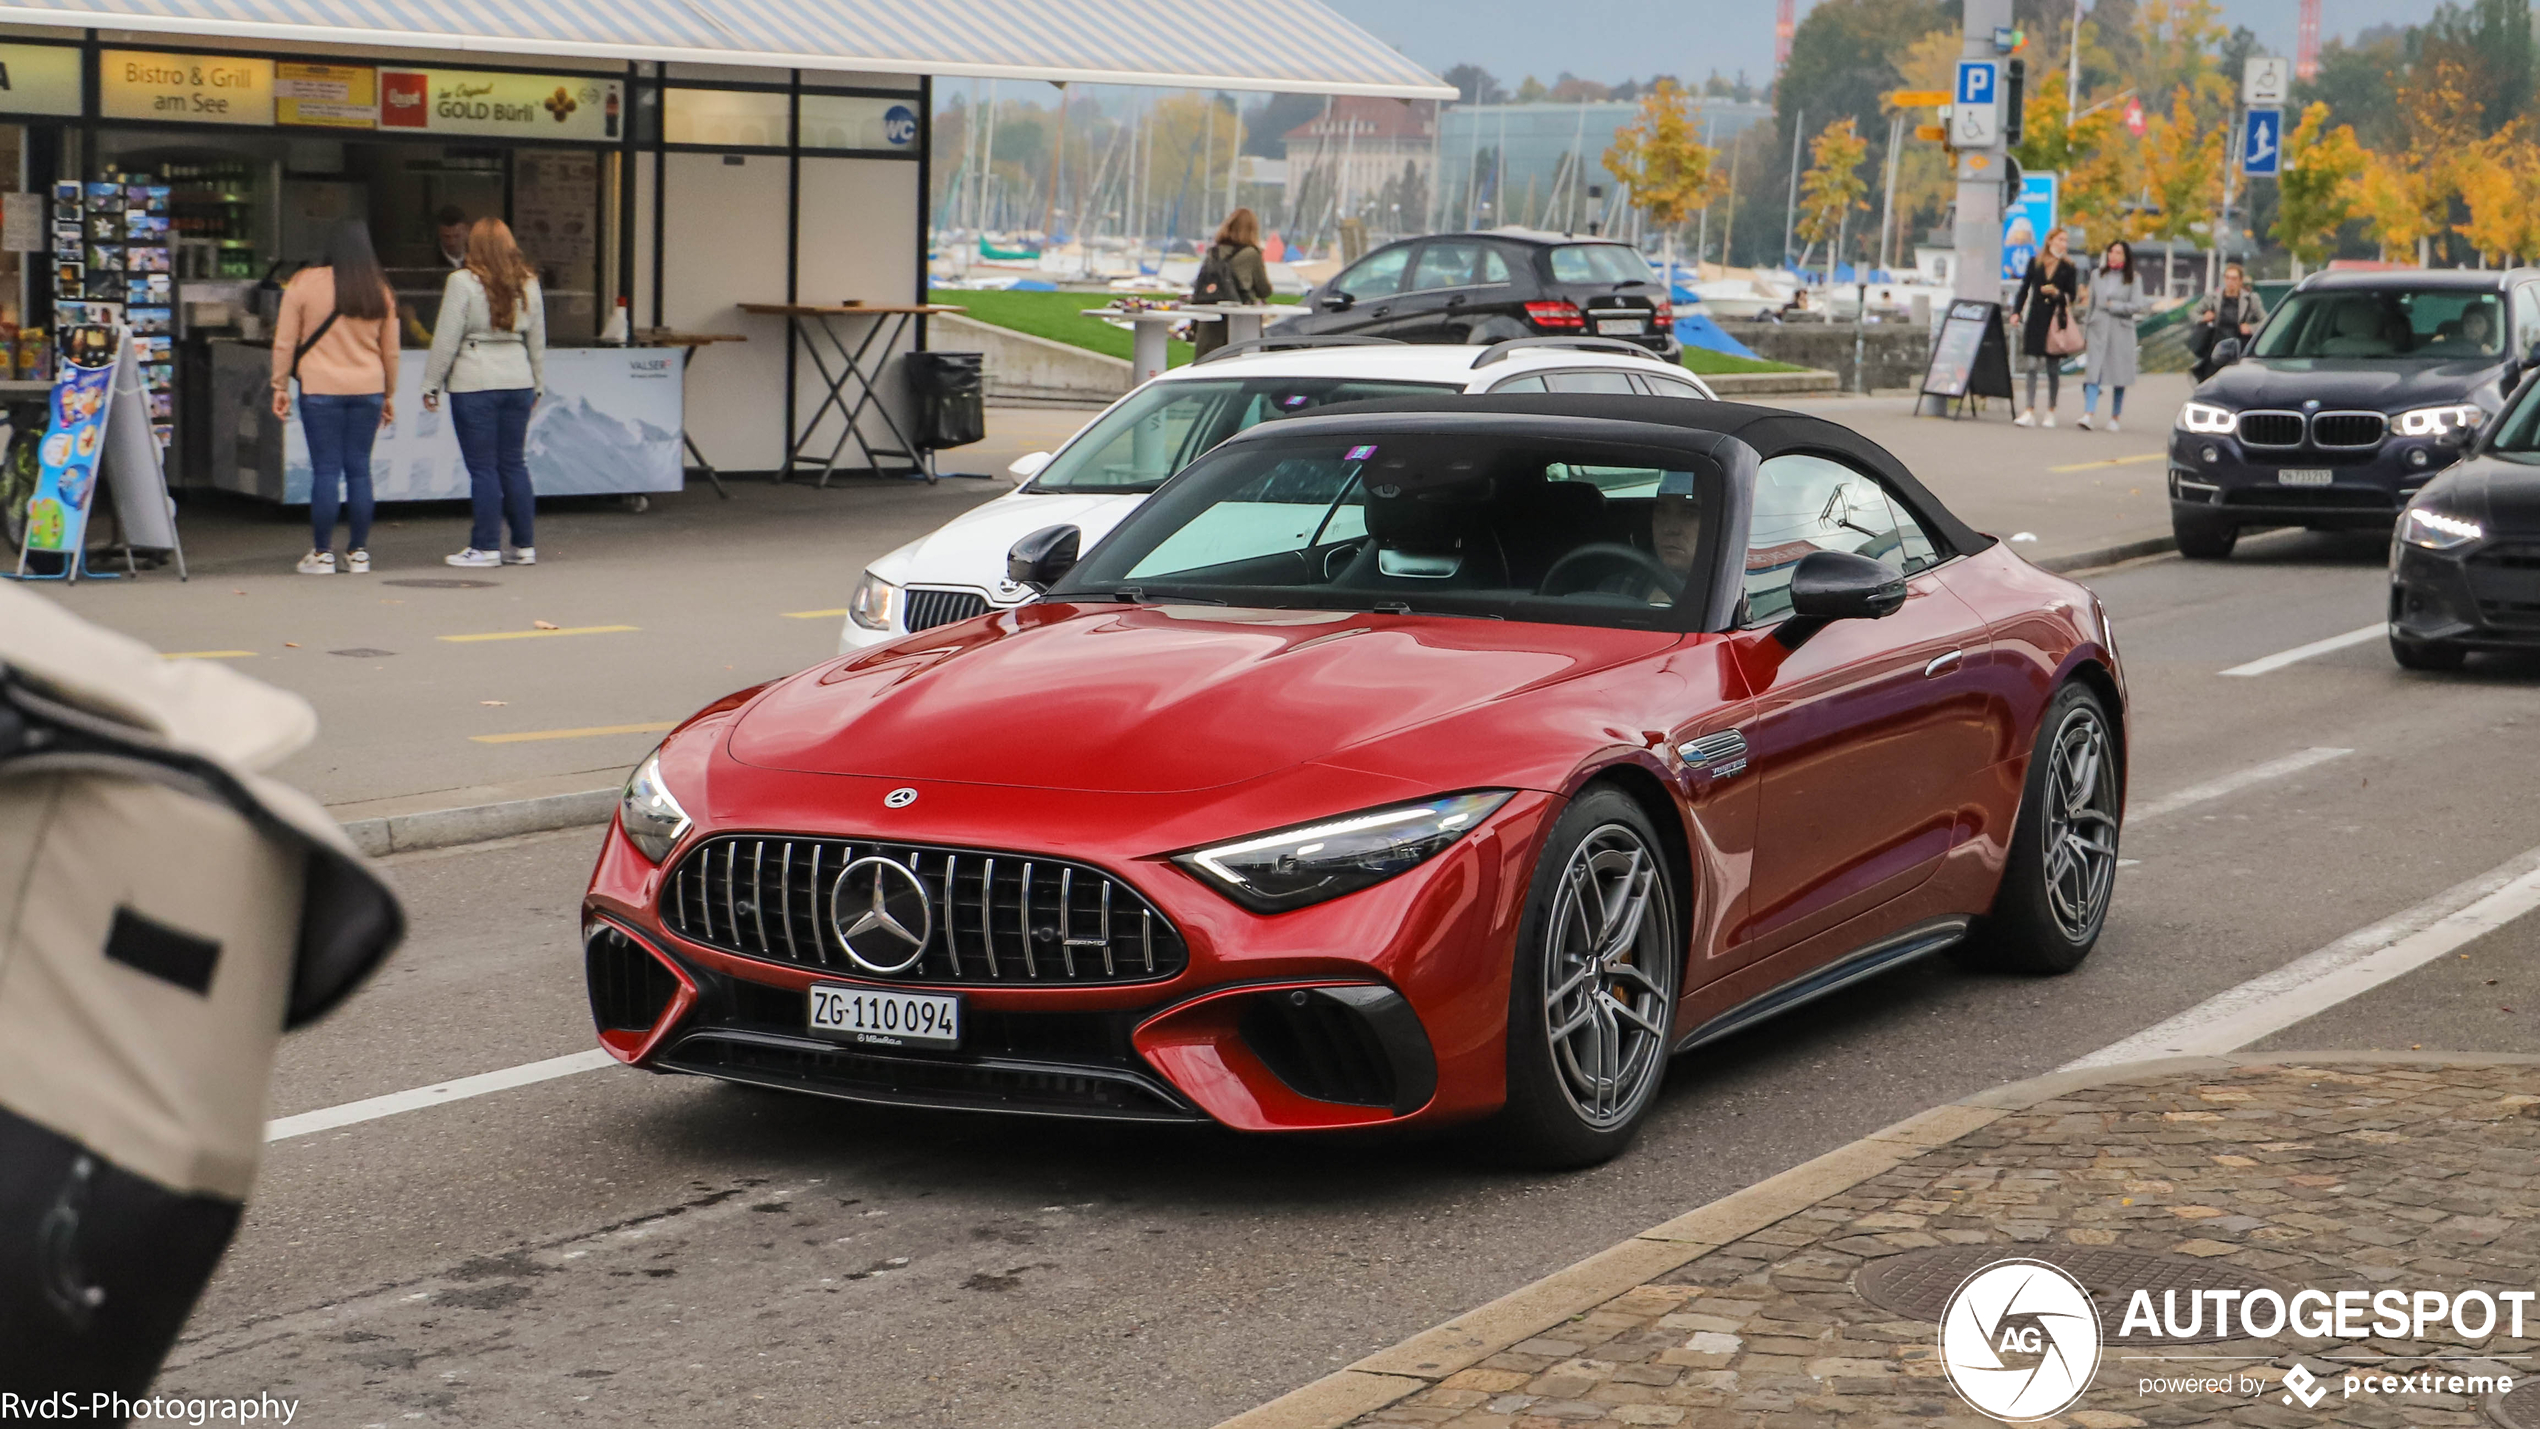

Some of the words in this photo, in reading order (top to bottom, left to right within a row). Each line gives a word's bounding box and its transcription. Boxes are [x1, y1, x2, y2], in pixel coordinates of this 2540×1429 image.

[125, 62, 185, 85] Bistro
[189, 66, 204, 86] &
[210, 67, 251, 88] Grill
[1966, 67, 1988, 101] P
[154, 94, 186, 111] am
[191, 92, 229, 114] See
[437, 100, 489, 120] GOLD
[493, 102, 535, 122] Bürli
[885, 119, 916, 141] WC
[1076, 939, 1107, 947] AMG
[904, 1000, 953, 1035] 094
